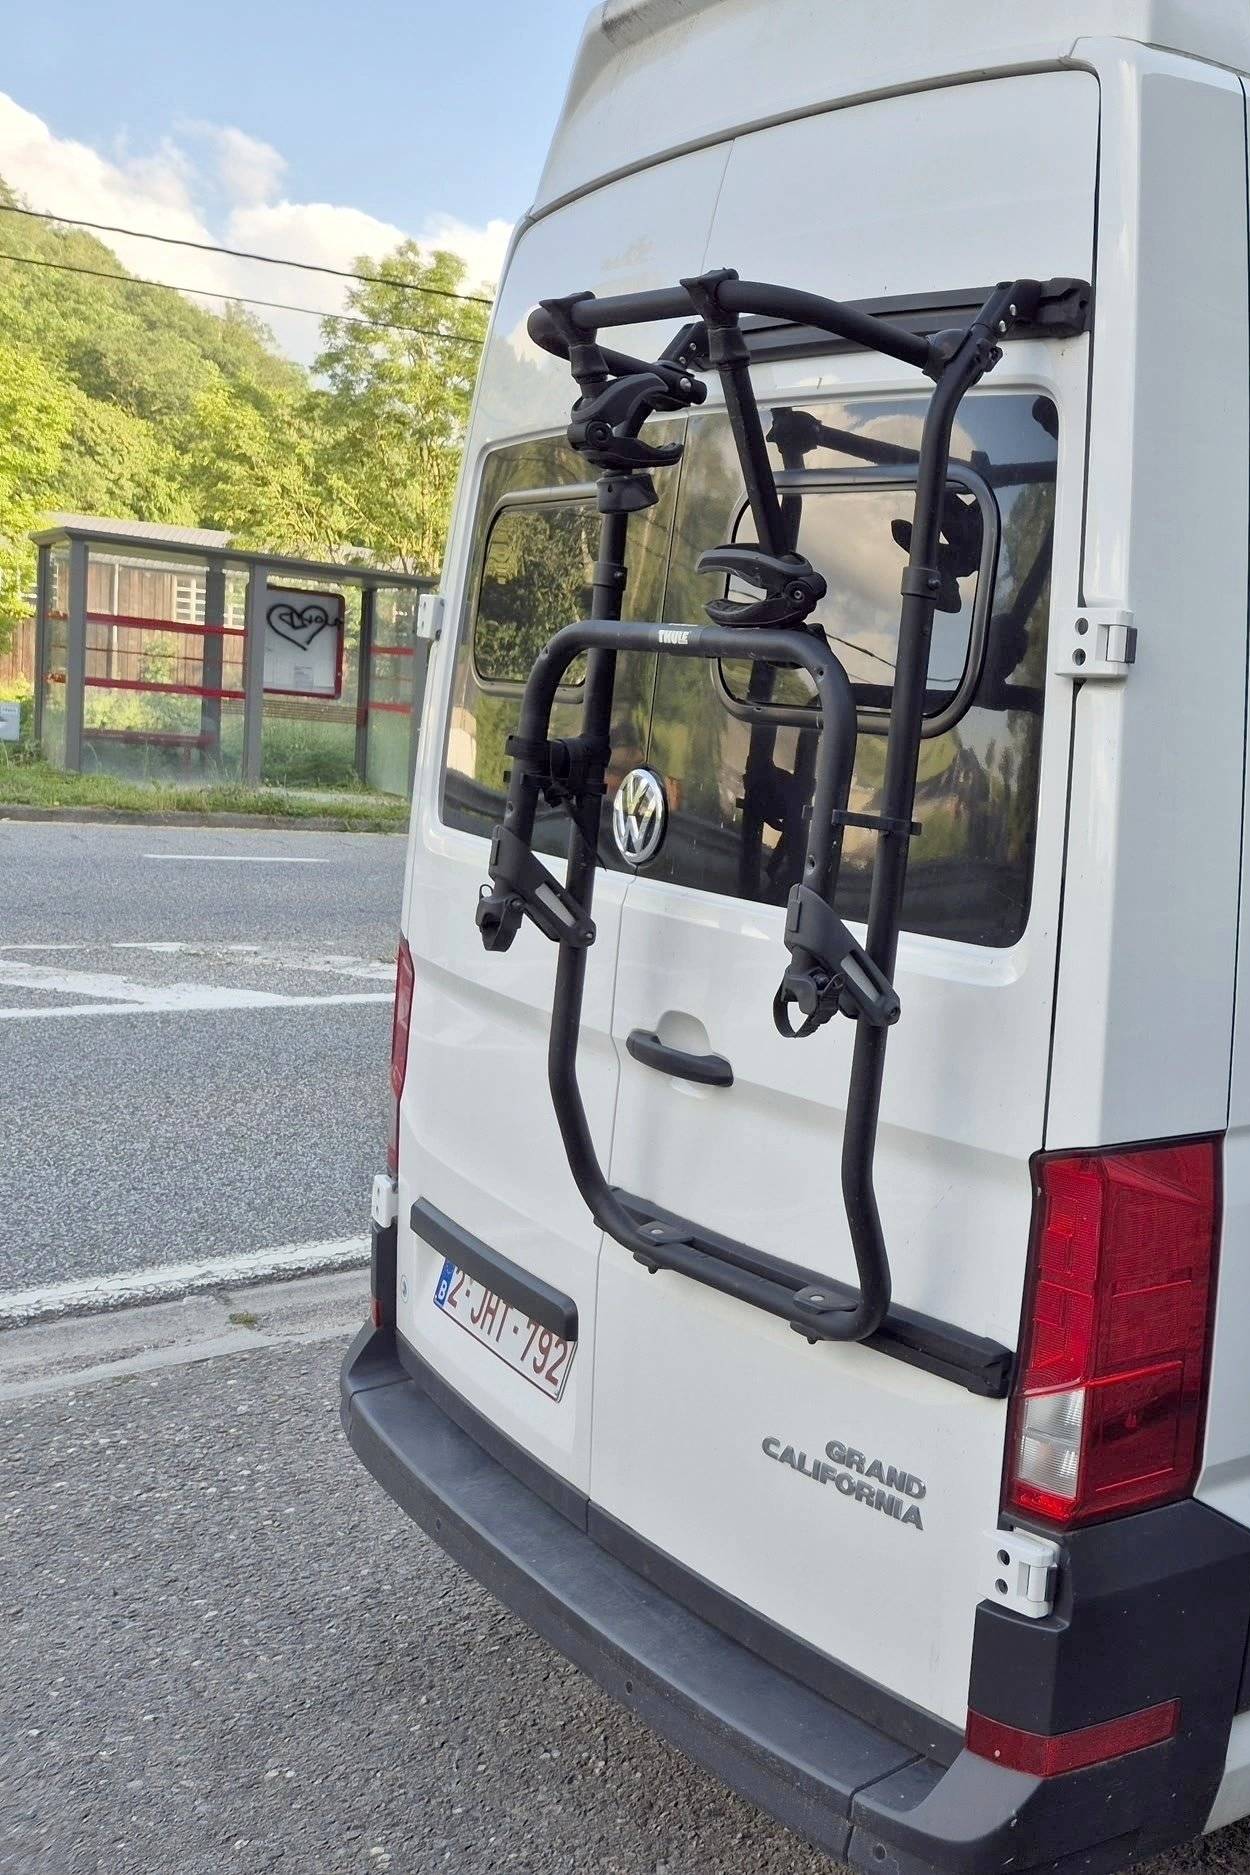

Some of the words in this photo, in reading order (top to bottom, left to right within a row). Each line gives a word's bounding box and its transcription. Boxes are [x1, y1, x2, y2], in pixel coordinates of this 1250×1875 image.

[658, 629, 690, 645] THULE
[761, 1436, 924, 1531] CALIFORNIA
[825, 1439, 927, 1500] GRAND
